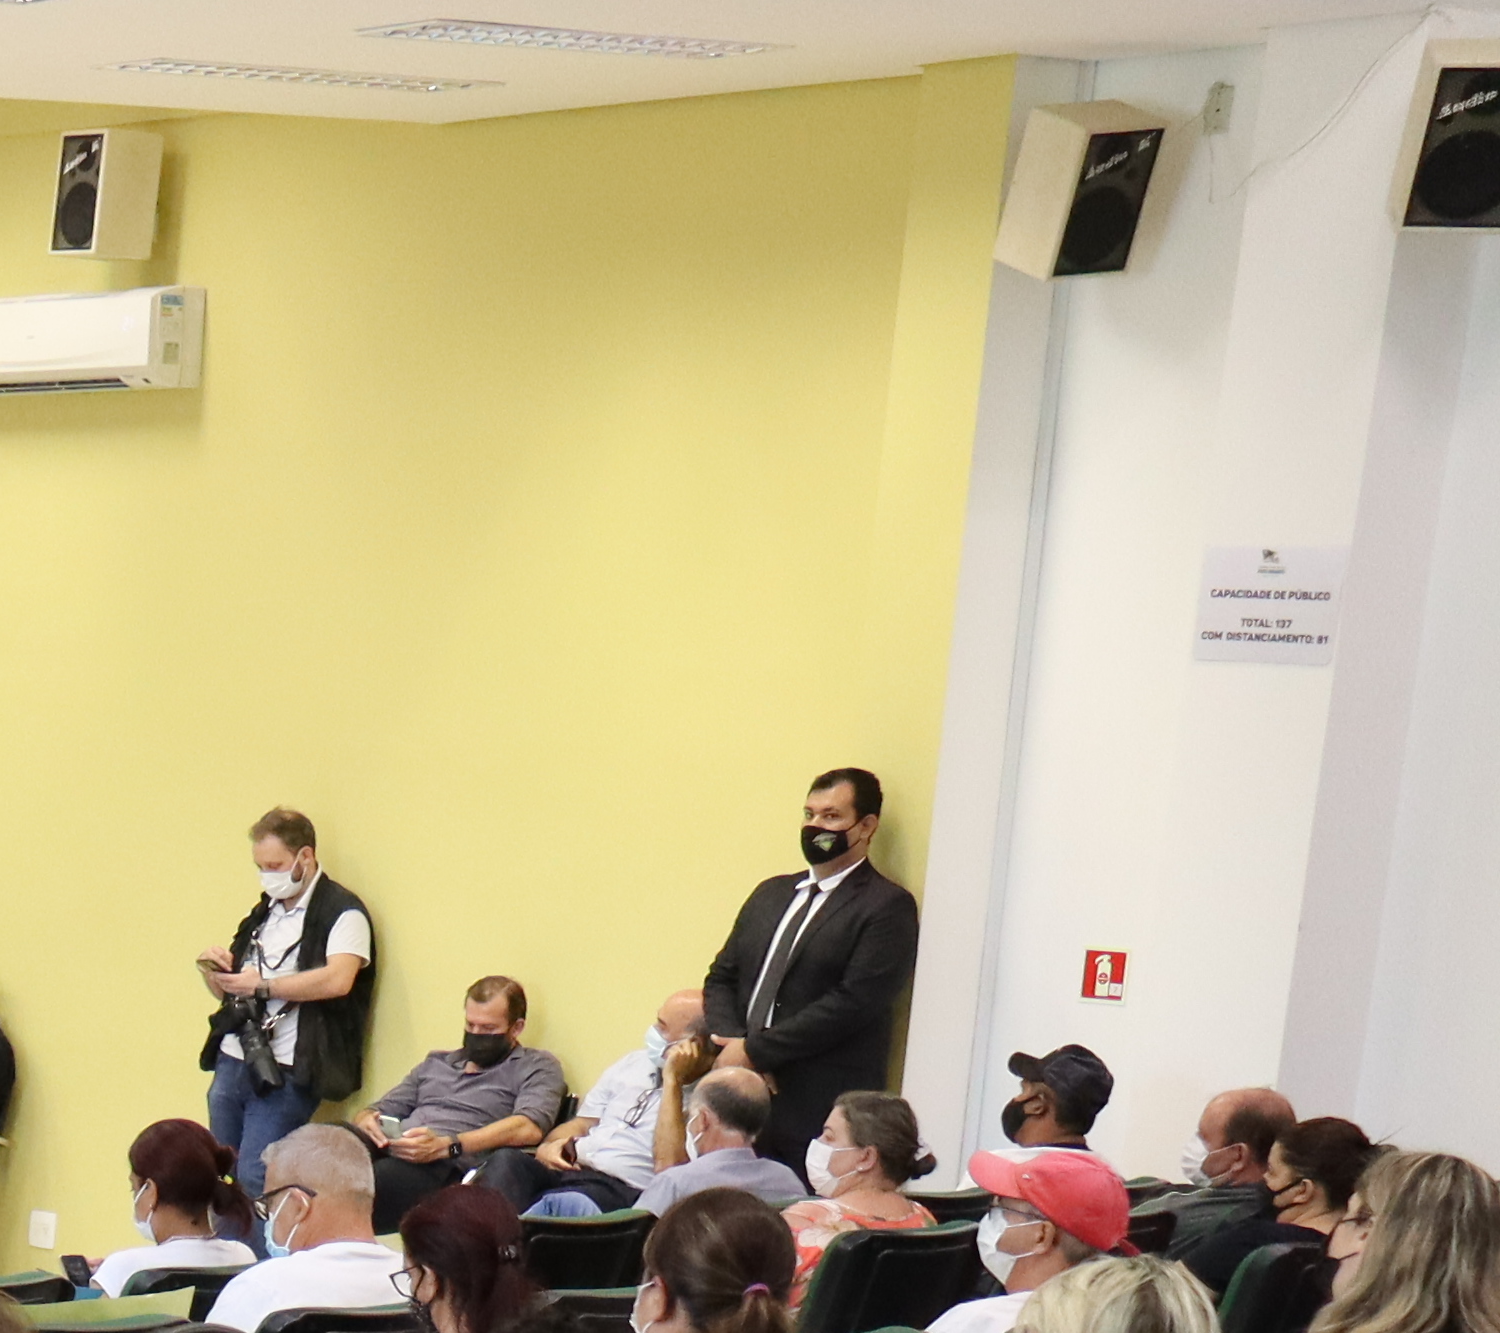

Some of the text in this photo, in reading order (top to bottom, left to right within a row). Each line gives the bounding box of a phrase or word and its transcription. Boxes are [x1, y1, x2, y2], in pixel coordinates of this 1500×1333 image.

[1210, 589, 1331, 601] CAPACIDADE DE PÚBLICO
[1241, 618, 1273, 628] TOTAL:
[1201, 631, 1222, 640] COM
[1226, 632, 1315, 644] DISTANCIAMENTO:
